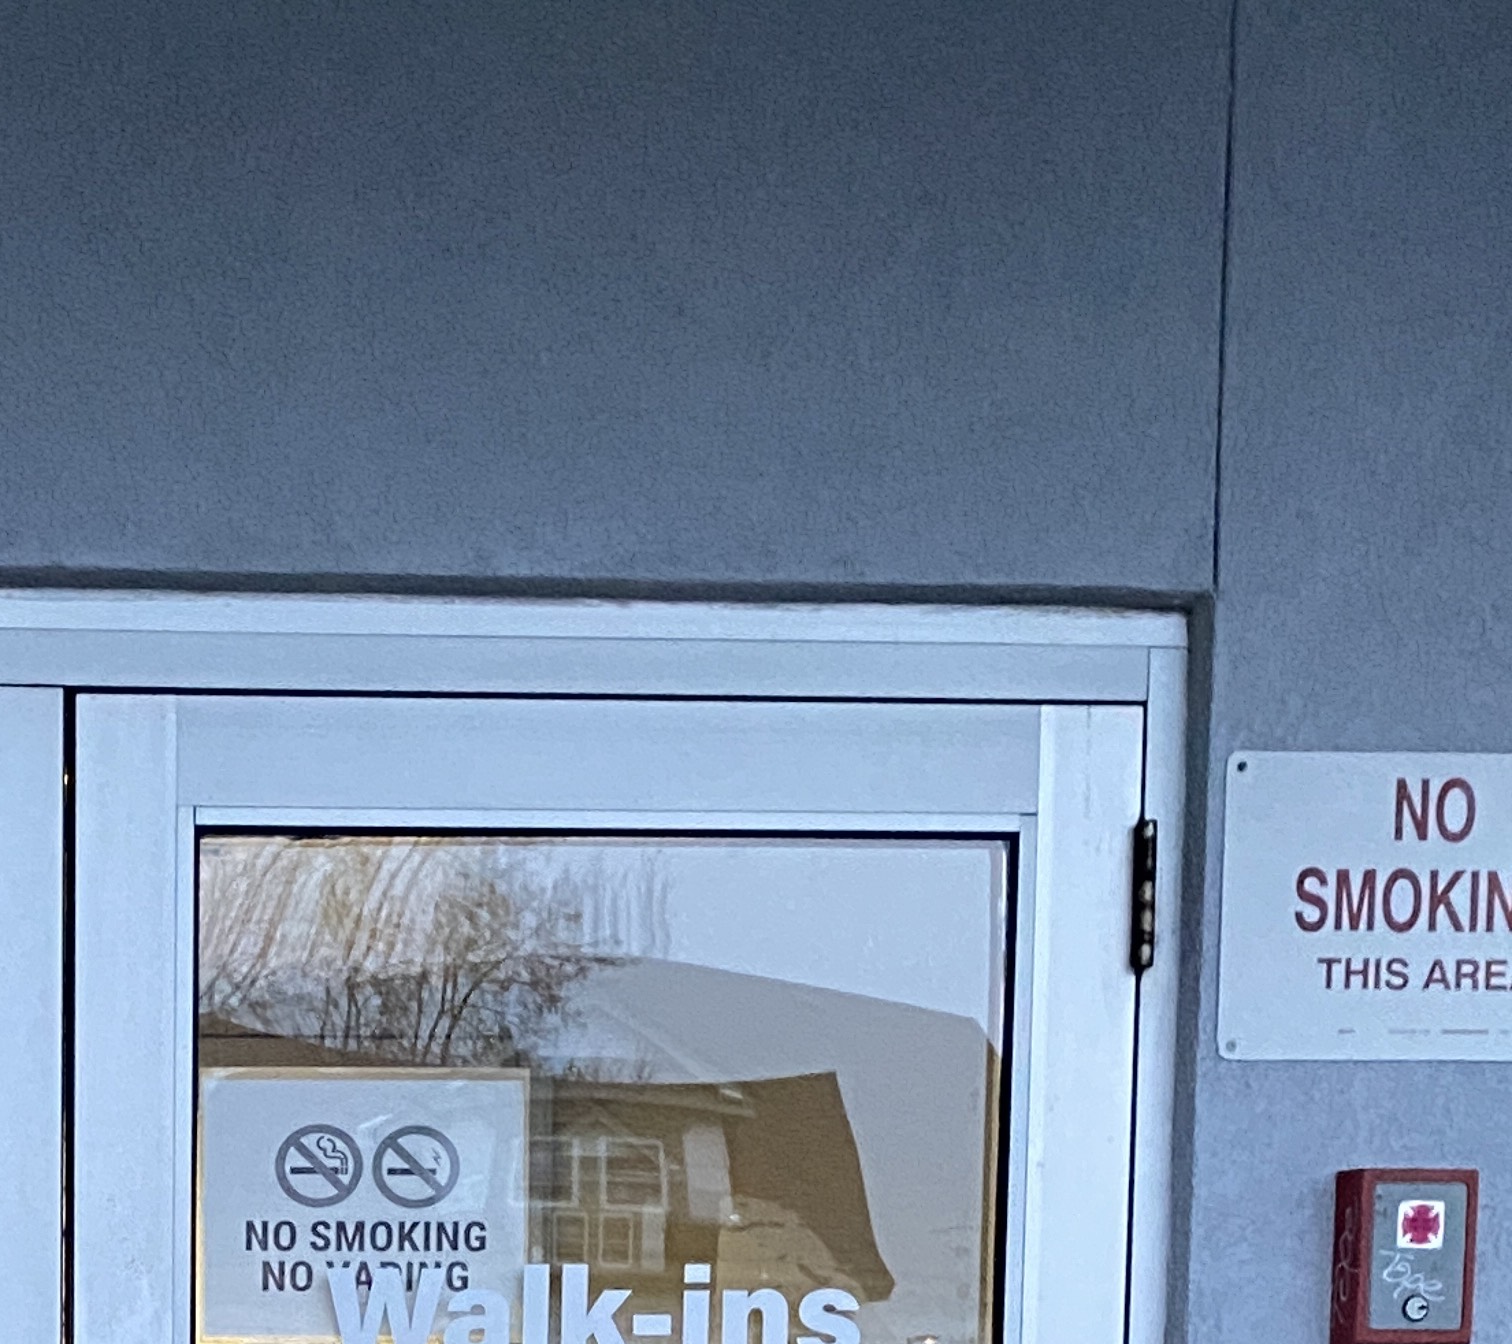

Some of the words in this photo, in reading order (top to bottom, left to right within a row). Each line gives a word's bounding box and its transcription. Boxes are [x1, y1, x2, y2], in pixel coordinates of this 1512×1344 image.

[1394, 777, 1476, 843] NO
[1317, 957, 1410, 991] THIS
[1422, 958, 1512, 991] ARE
[245, 1220, 297, 1251] NO
[310, 1220, 487, 1252] SMOKING
[262, 1260, 313, 1292] NO
[326, 1260, 469, 1292] AIG
